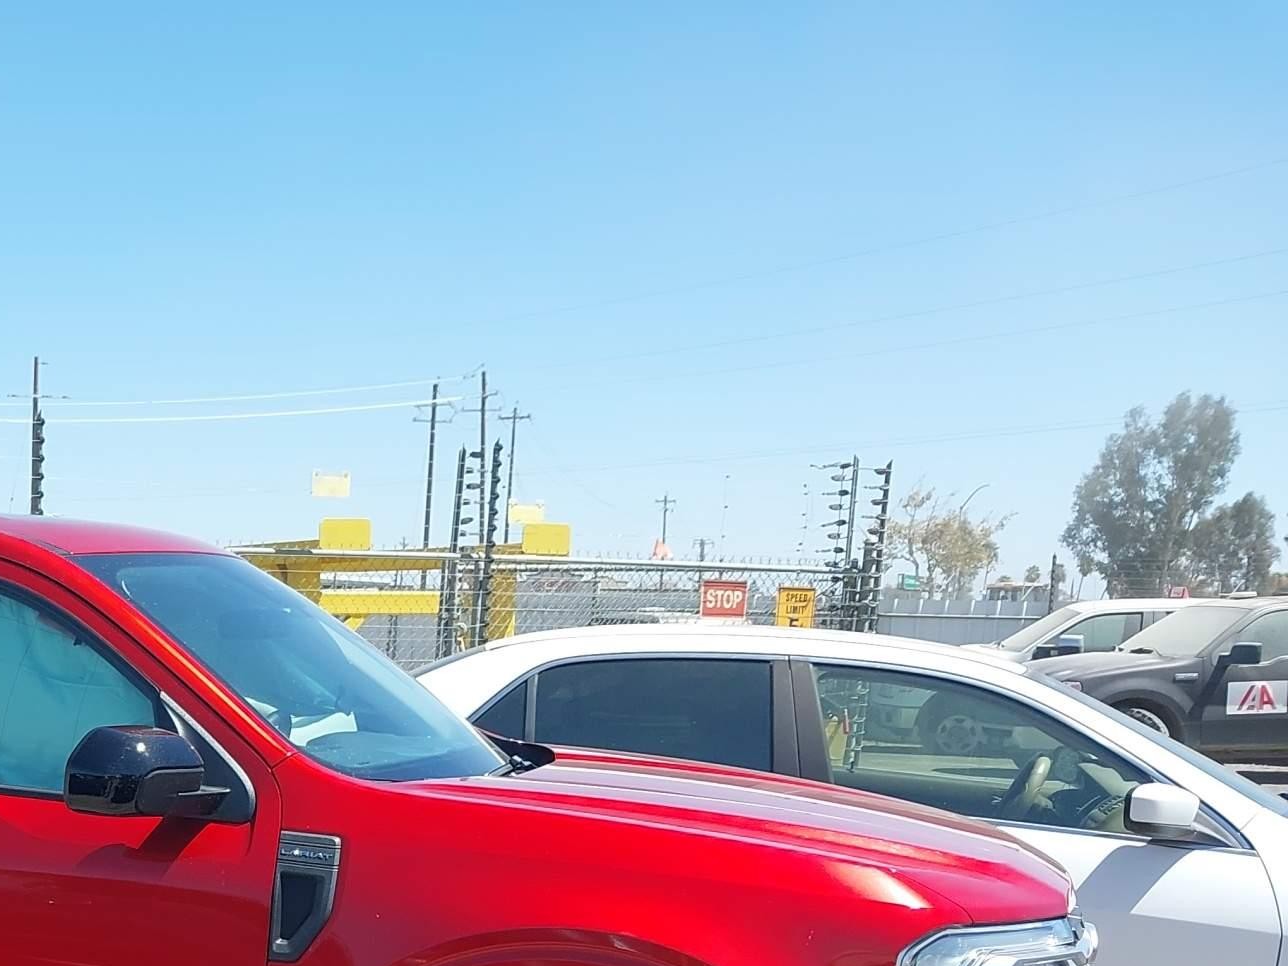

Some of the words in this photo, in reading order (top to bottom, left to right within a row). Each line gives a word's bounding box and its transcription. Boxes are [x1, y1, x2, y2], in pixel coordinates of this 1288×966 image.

[706, 589, 743, 609] STOP
[786, 592, 809, 603] SPEED
[786, 605, 807, 615] LIMIT
[280, 847, 333, 860] LARIAT
